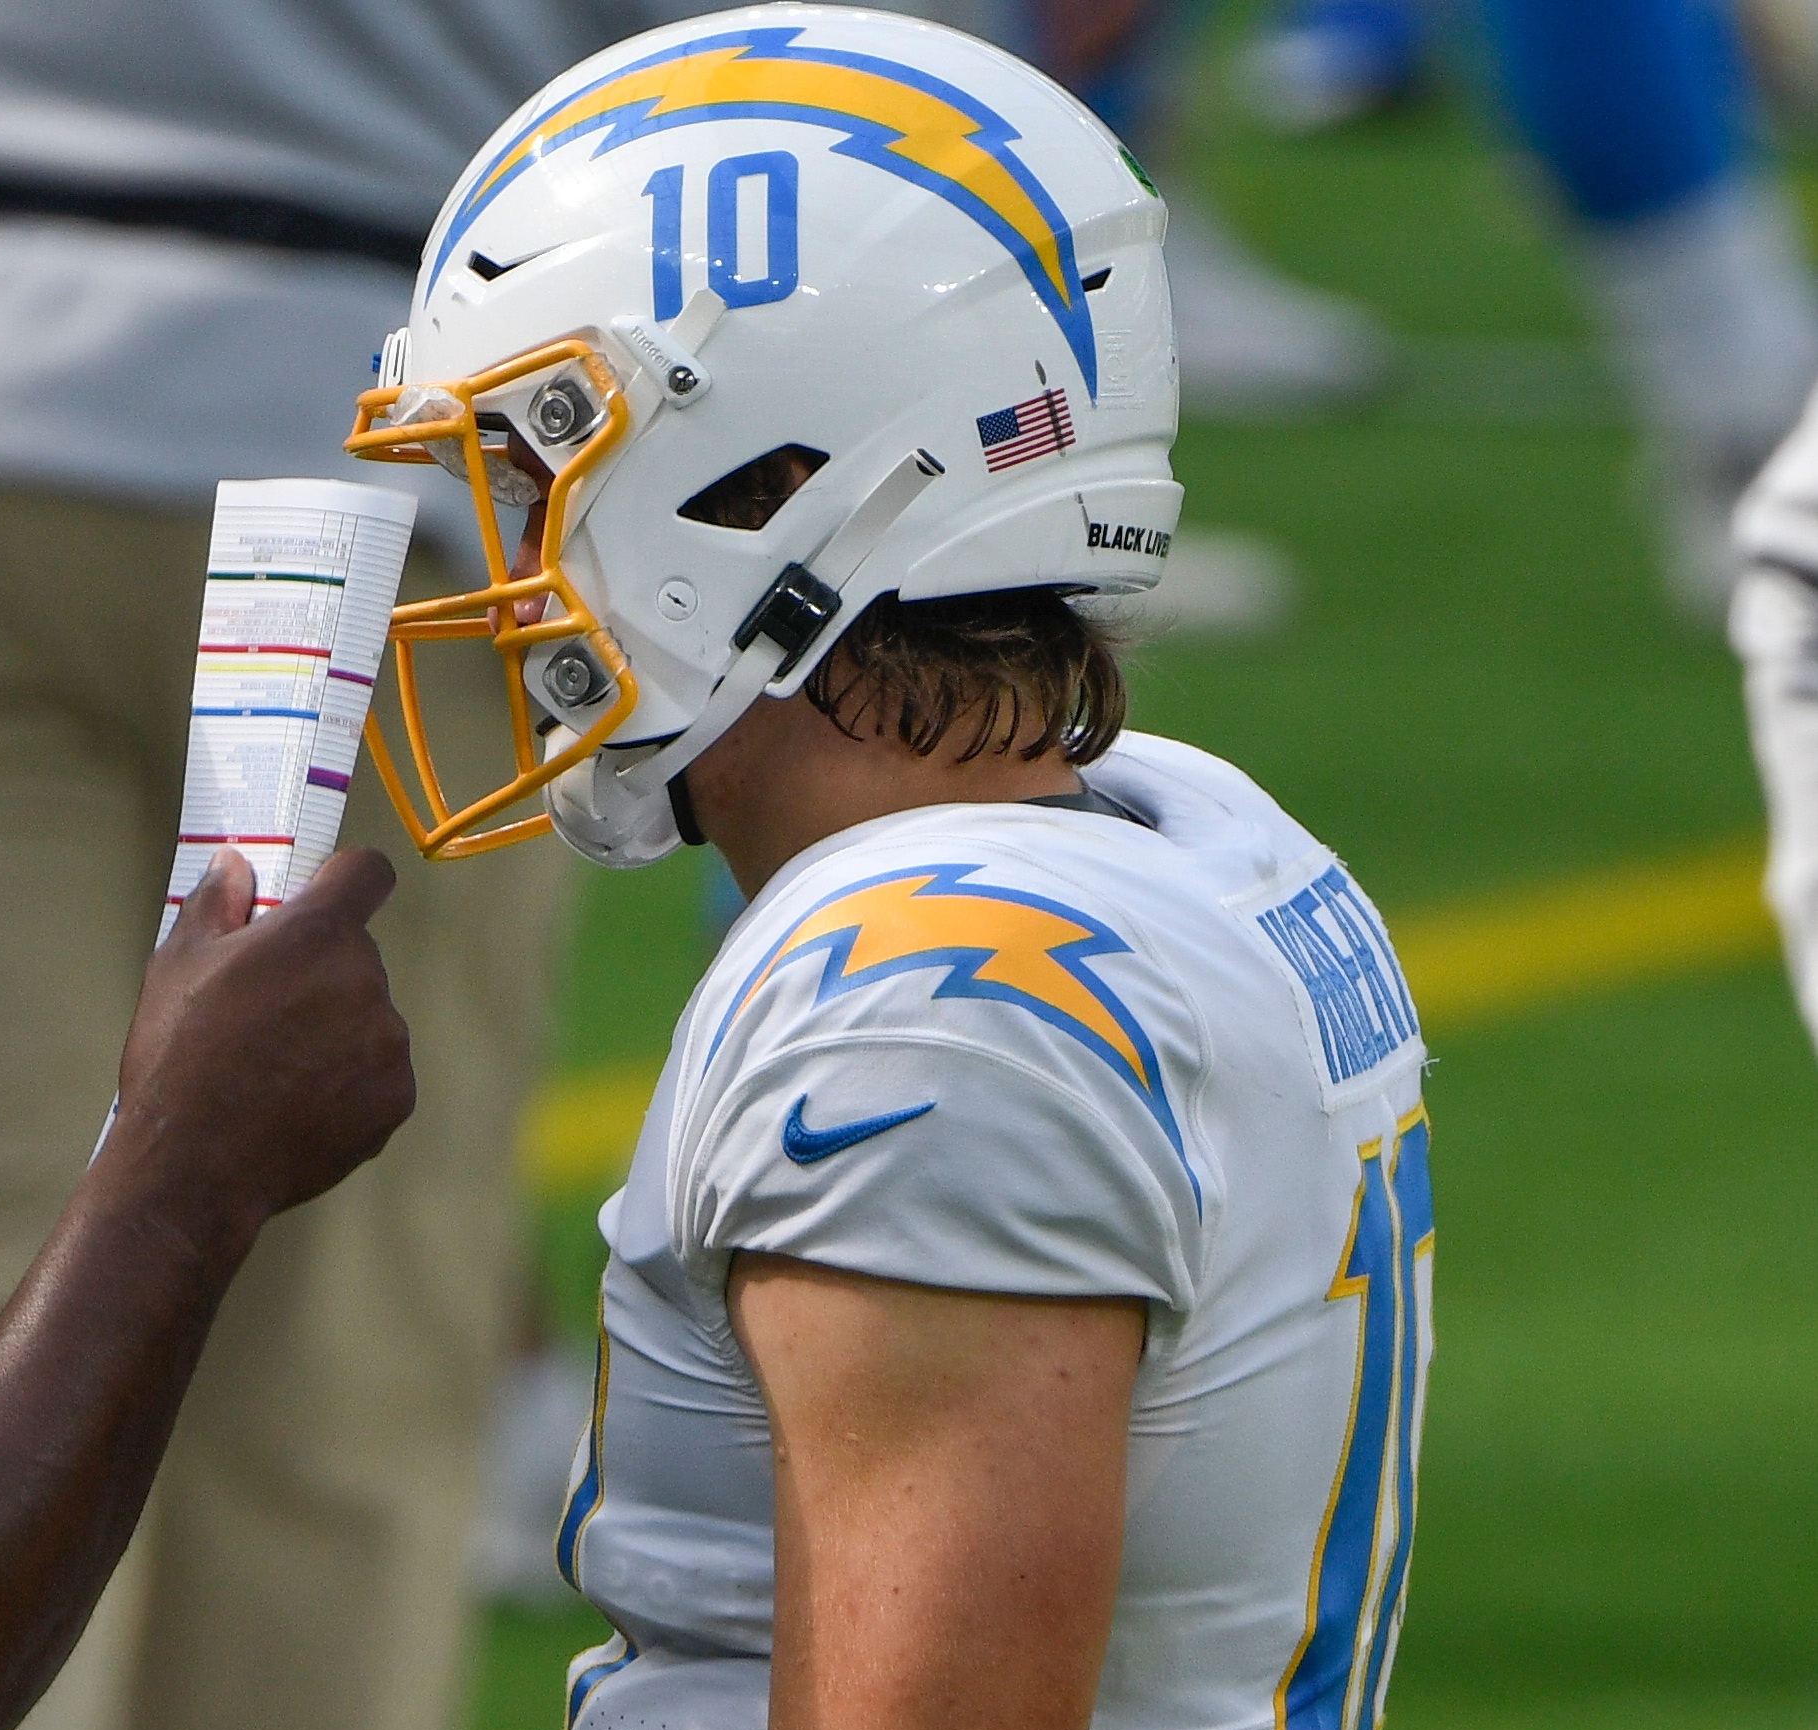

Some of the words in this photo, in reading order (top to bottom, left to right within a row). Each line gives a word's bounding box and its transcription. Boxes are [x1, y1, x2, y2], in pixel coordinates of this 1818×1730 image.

[640, 150, 799, 322] 10
[1087, 522, 1146, 553] BLACK
[1144, 529, 1172, 559] LIVE
